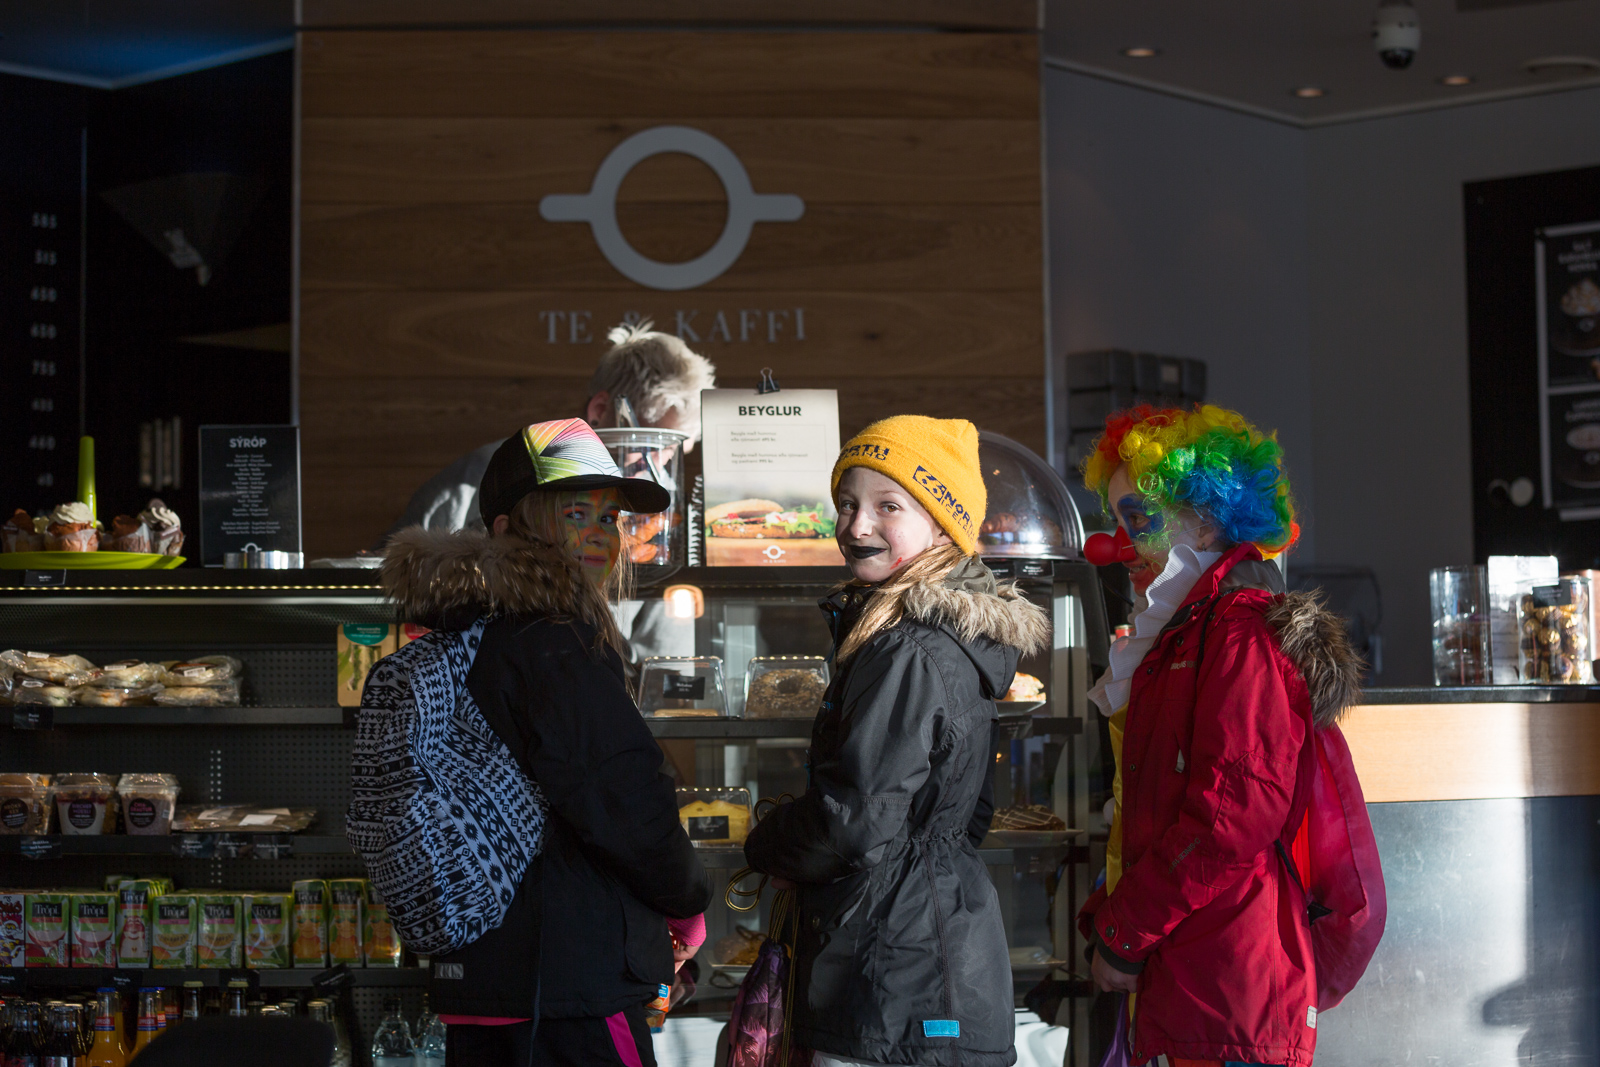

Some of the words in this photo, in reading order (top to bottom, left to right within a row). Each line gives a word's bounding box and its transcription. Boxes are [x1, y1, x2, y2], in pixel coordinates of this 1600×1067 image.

[539, 314, 593, 344] TE
[673, 312, 806, 343] KAFFI
[738, 405, 802, 416] BEYGLUR
[228, 435, 268, 449] SÝRÓP
